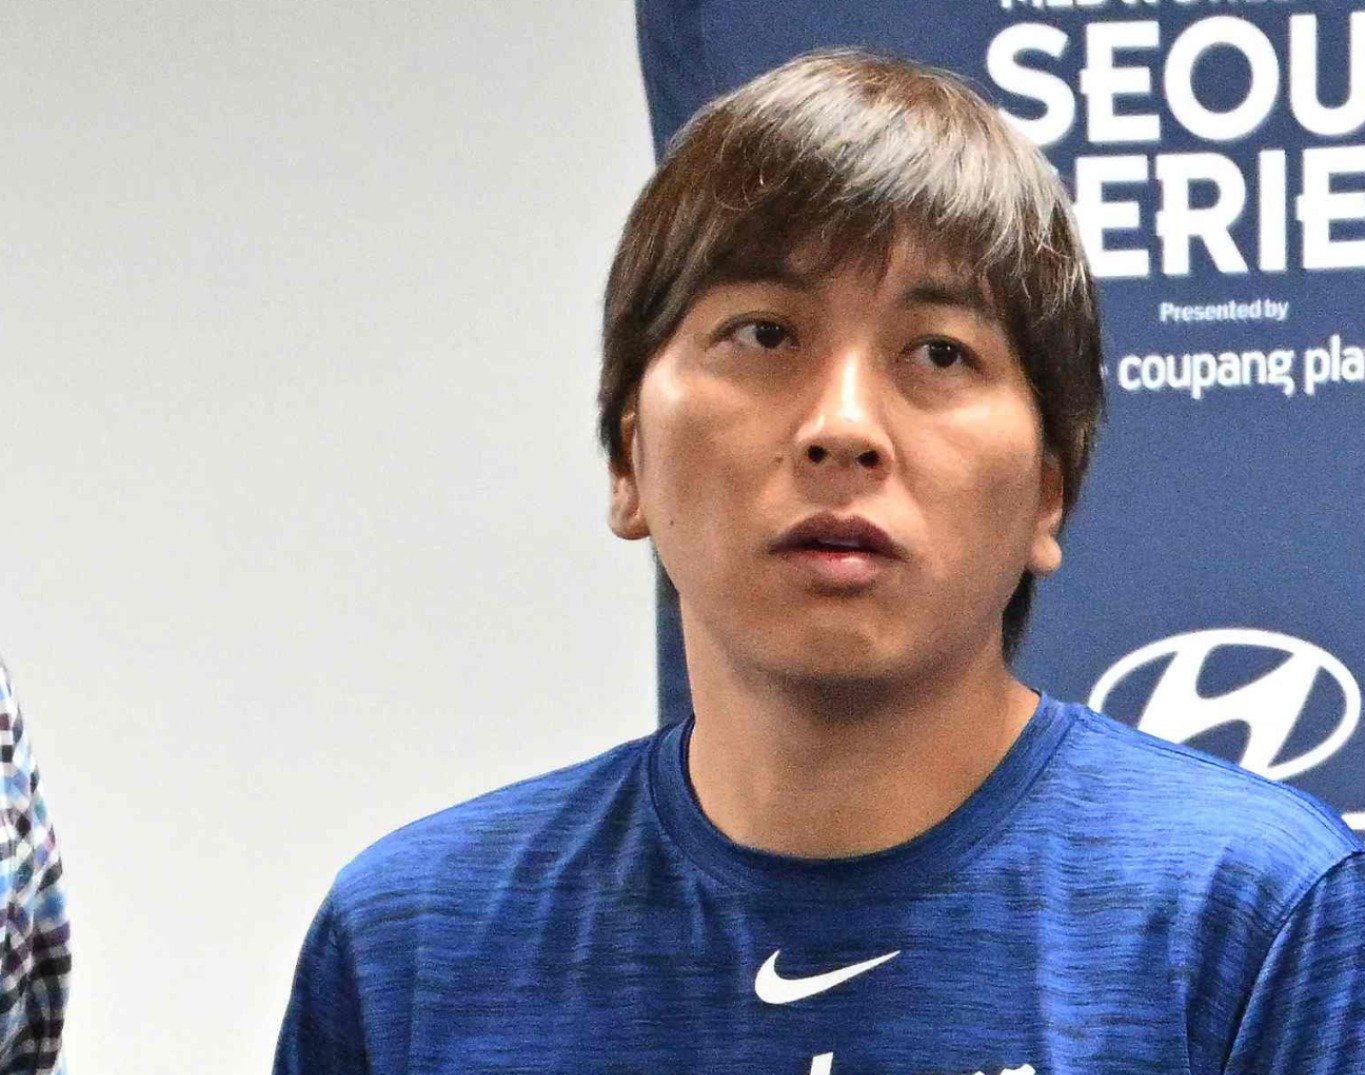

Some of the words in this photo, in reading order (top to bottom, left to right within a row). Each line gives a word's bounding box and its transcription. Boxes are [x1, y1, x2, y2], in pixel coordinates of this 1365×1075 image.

[1160, 300, 1262, 322] Presented
[1263, 299, 1290, 321] by
[1118, 347, 1296, 399] coupang
